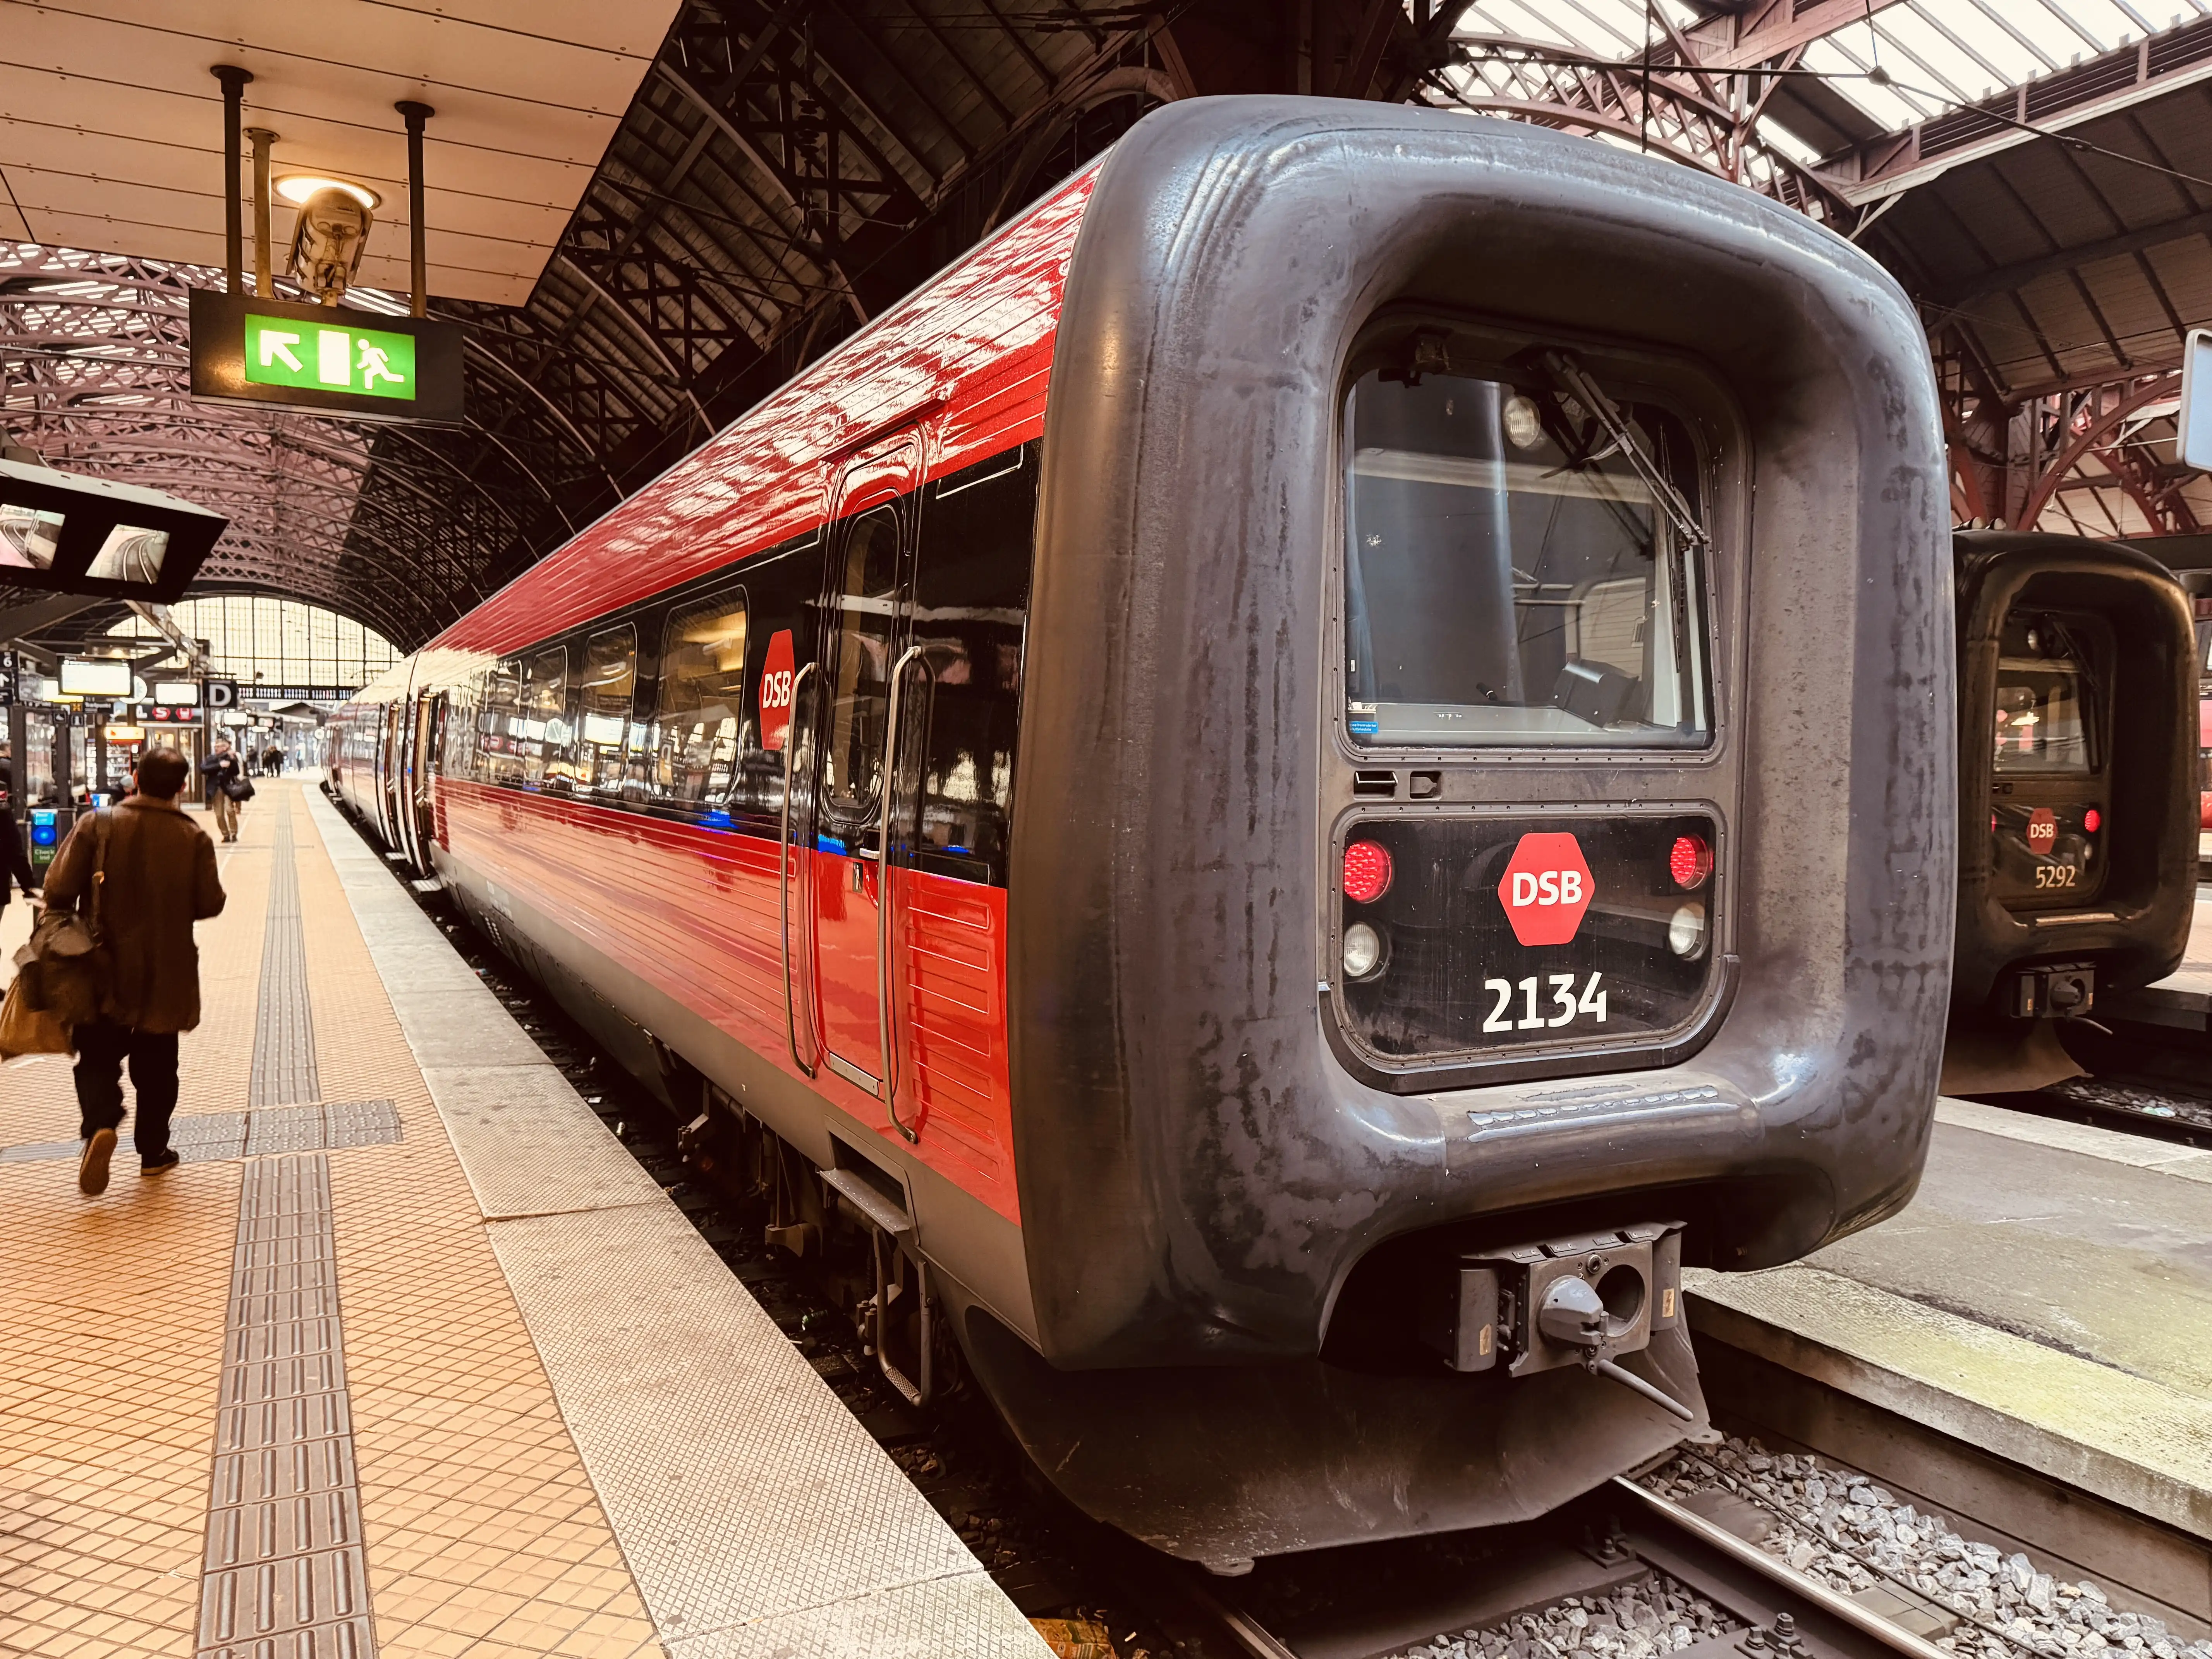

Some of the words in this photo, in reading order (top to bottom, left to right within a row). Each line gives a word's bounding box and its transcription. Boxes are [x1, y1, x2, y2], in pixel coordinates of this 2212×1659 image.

[3, 656, 12, 667] 6
[209, 684, 232, 706] D
[763, 670, 791, 708] DSB
[2030, 823, 2054, 838] DSB
[1512, 870, 1582, 907] DSB
[2035, 865, 2076, 889] 5292
[1482, 971, 1607, 1033] 2134
